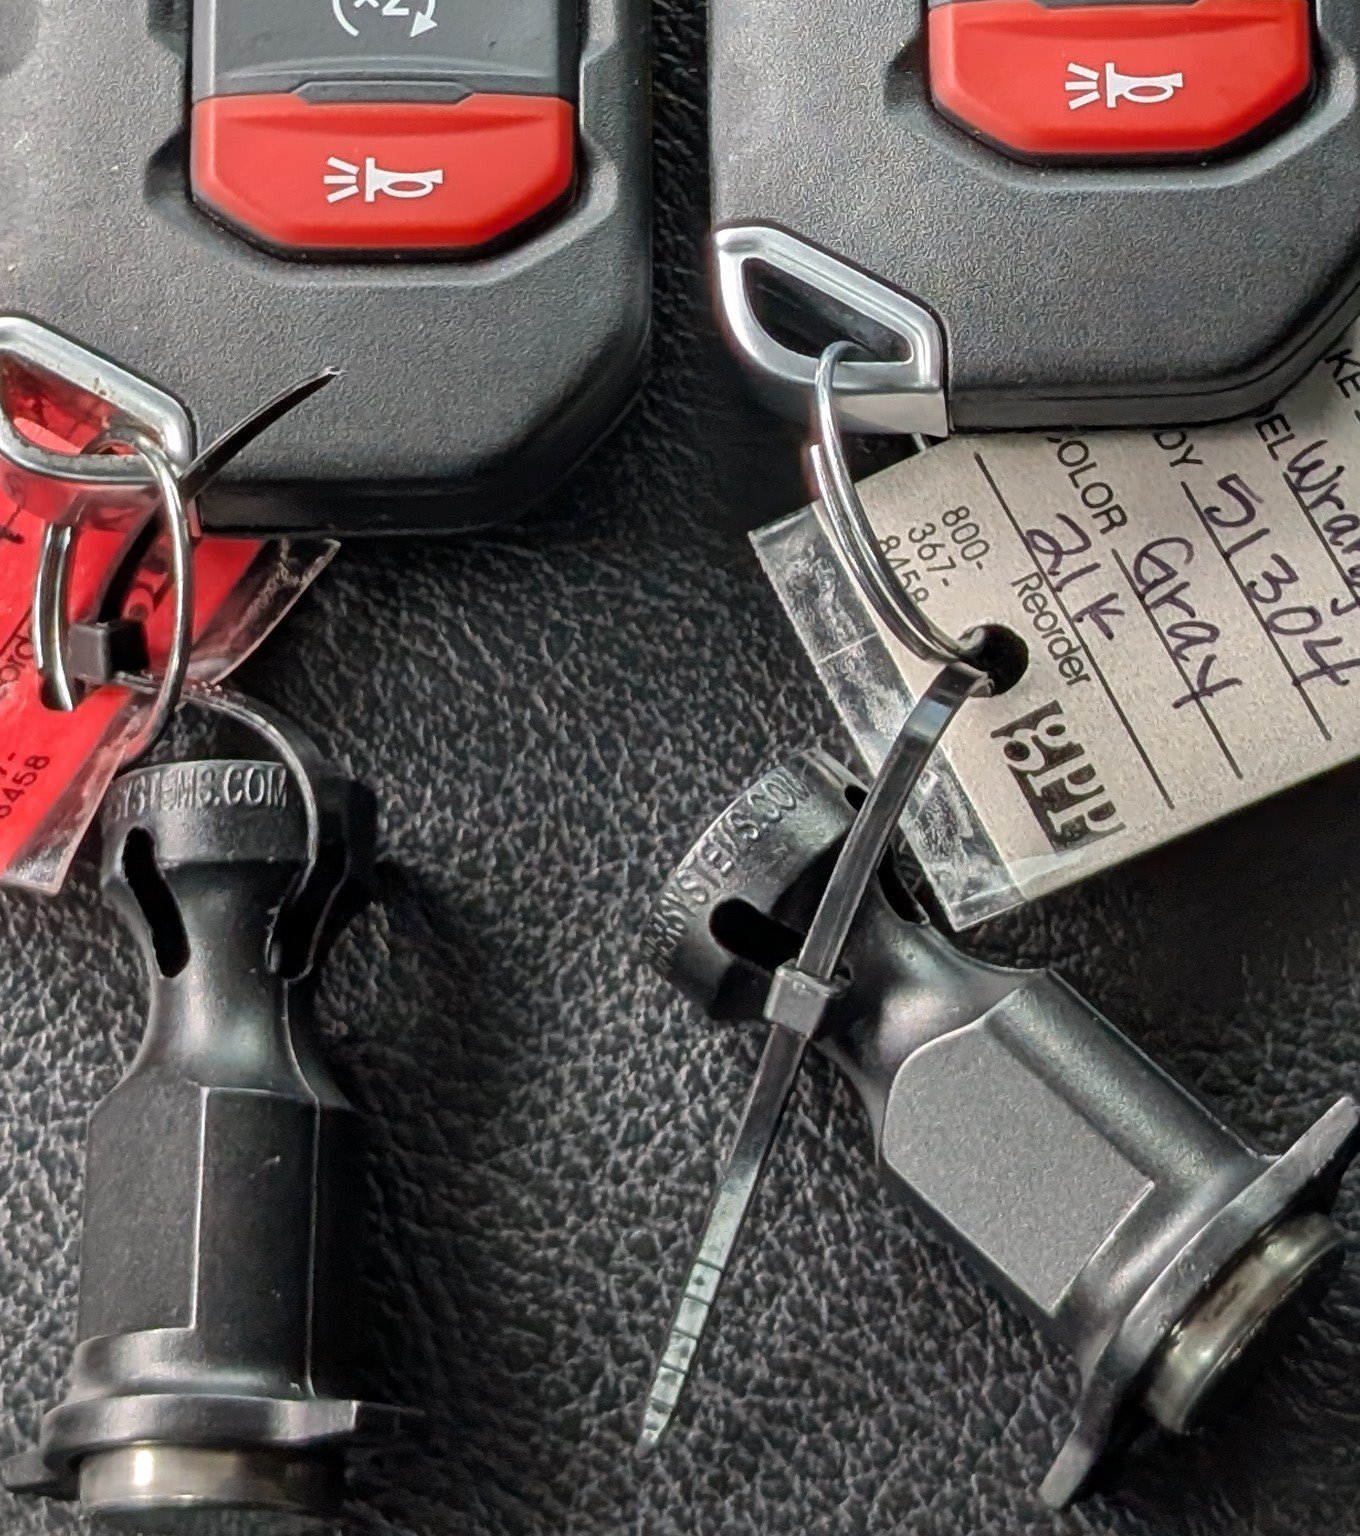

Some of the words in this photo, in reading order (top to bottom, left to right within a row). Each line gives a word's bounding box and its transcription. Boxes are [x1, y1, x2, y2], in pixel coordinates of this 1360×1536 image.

[1152, 428, 1203, 468] DY
[908, 522, 957, 587] 367-
[941, 505, 990, 570] 800-
[1047, 436, 1128, 535] OLOR
[1133, 536, 1243, 709] Gray
[1011, 571, 1092, 686] Reorder
